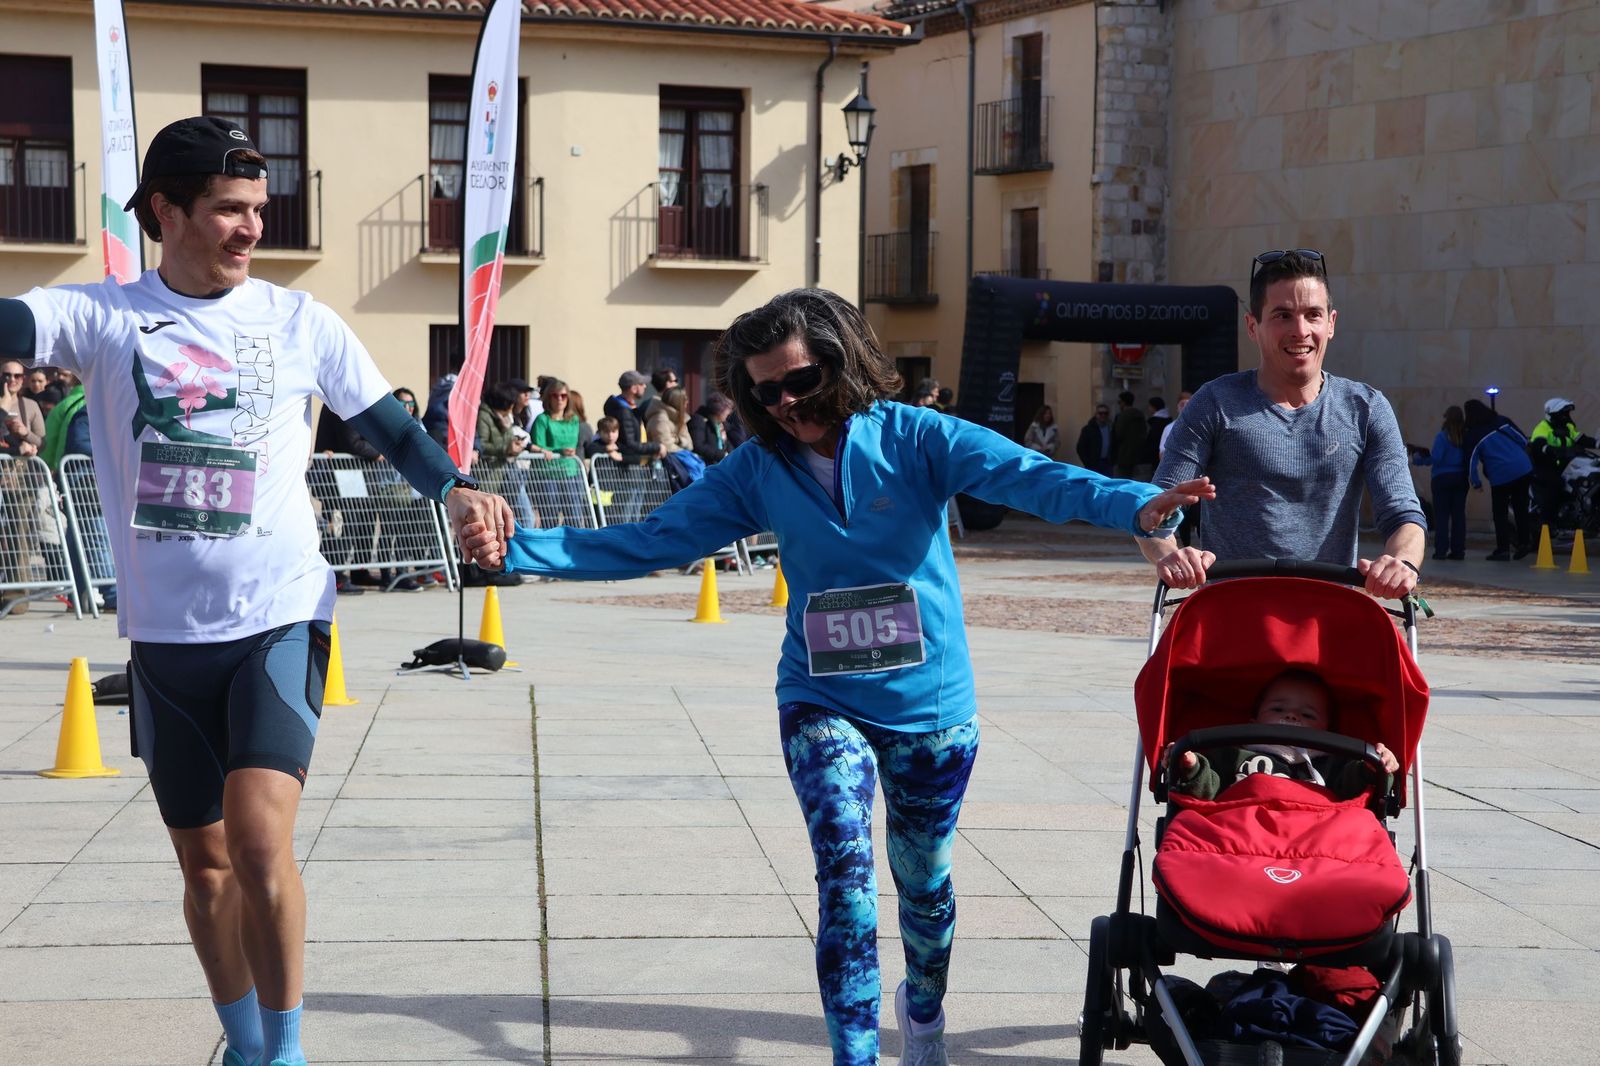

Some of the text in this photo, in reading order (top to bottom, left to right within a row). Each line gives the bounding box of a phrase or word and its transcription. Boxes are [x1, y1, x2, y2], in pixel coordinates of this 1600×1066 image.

[1150, 305, 1207, 322] zamora
[160, 467, 231, 508] 783
[827, 607, 897, 648] 505
